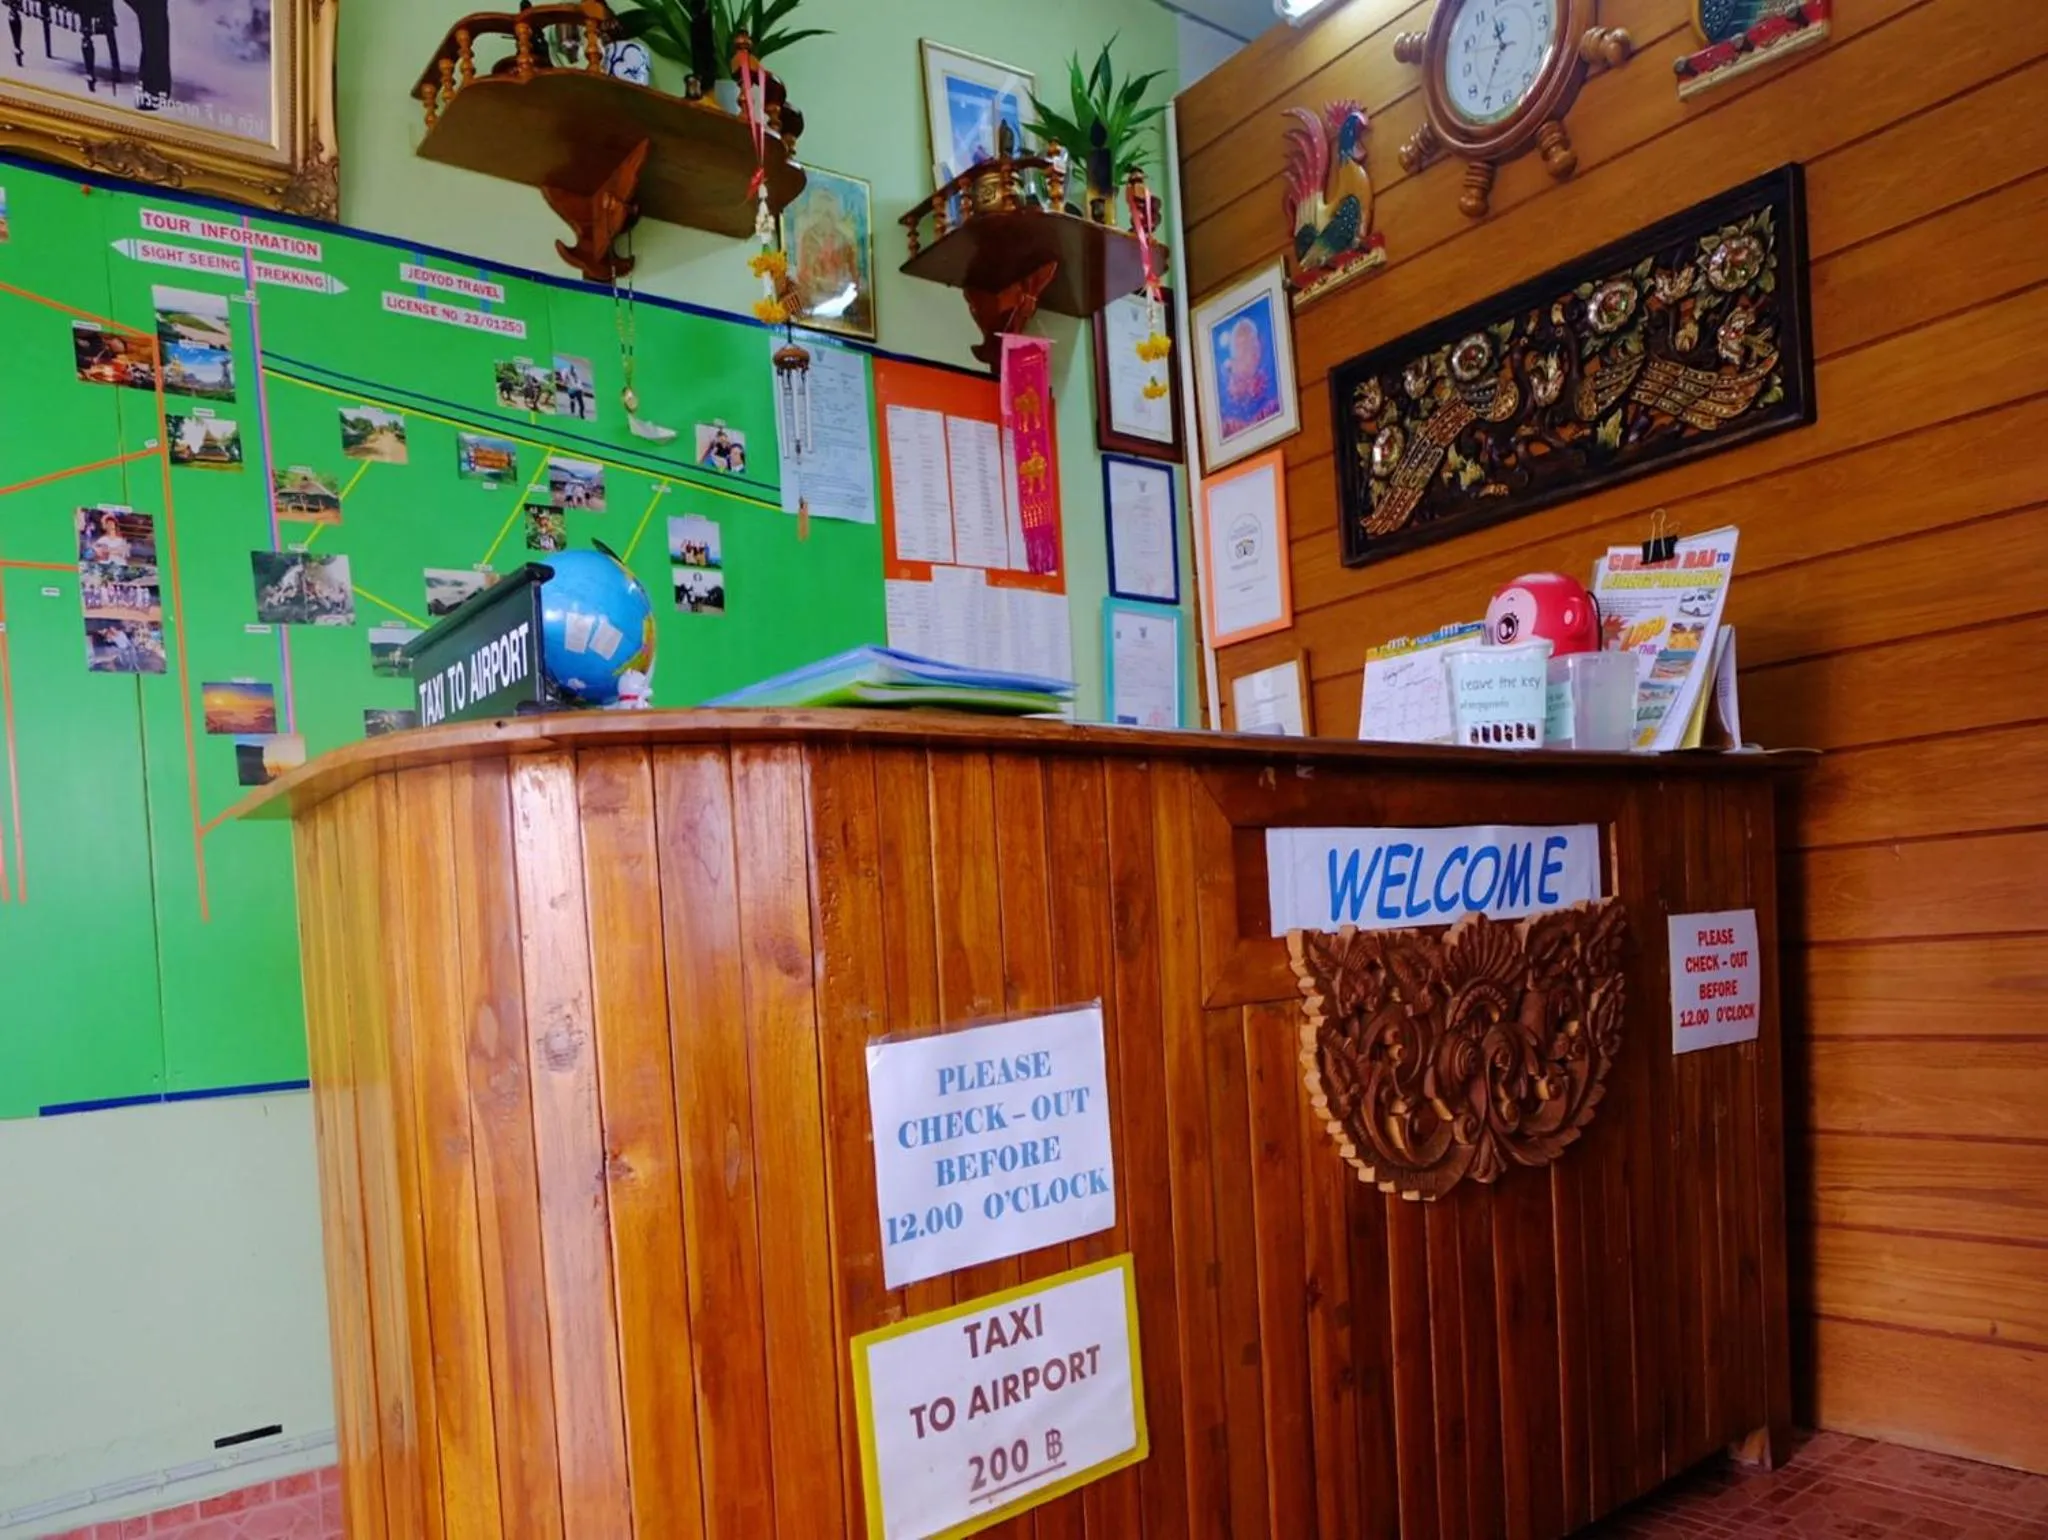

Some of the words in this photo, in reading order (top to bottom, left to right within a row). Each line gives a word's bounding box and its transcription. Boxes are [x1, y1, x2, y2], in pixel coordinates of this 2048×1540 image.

[142, 212, 191, 232] TOUR
[201, 222, 319, 256] INFORMATION
[141, 245, 183, 262] SIGHT
[189, 253, 241, 272] SEEING
[256, 266, 325, 287] TREKKING
[408, 267, 454, 287] JEDYOD
[457, 279, 500, 299] TRAVEL
[386, 296, 439, 316] LICENSE
[418, 672, 445, 728] TAXI
[448, 660, 465, 713] TO
[470, 621, 529, 704] AIRPORT
[1460, 678, 1494, 692] Leave
[1499, 676, 1517, 689] the
[1521, 675, 1541, 691] key
[1328, 836, 1568, 921] WELCOME
[1698, 928, 1734, 946] PLEASE
[1685, 954, 1720, 974] CHECK
[1730, 951, 1748, 968] OUT
[1699, 980, 1738, 1000] BEFORE
[1680, 1008, 1710, 1028] 12.00
[1716, 1003, 1756, 1023] O'CLOCK
[937, 1051, 1051, 1096] PLEASE
[898, 1102, 1007, 1149] CHECK
[1031, 1087, 1090, 1122] OUT
[936, 1136, 1061, 1187] BEFORE
[886, 1201, 964, 1246] 12.00
[983, 1168, 1109, 1220] O'CLOCK
[964, 1303, 1043, 1358] TAXI
[910, 1396, 956, 1439] TO
[968, 1344, 1101, 1420] AIRPORT
[968, 1439, 1029, 1492] 200
